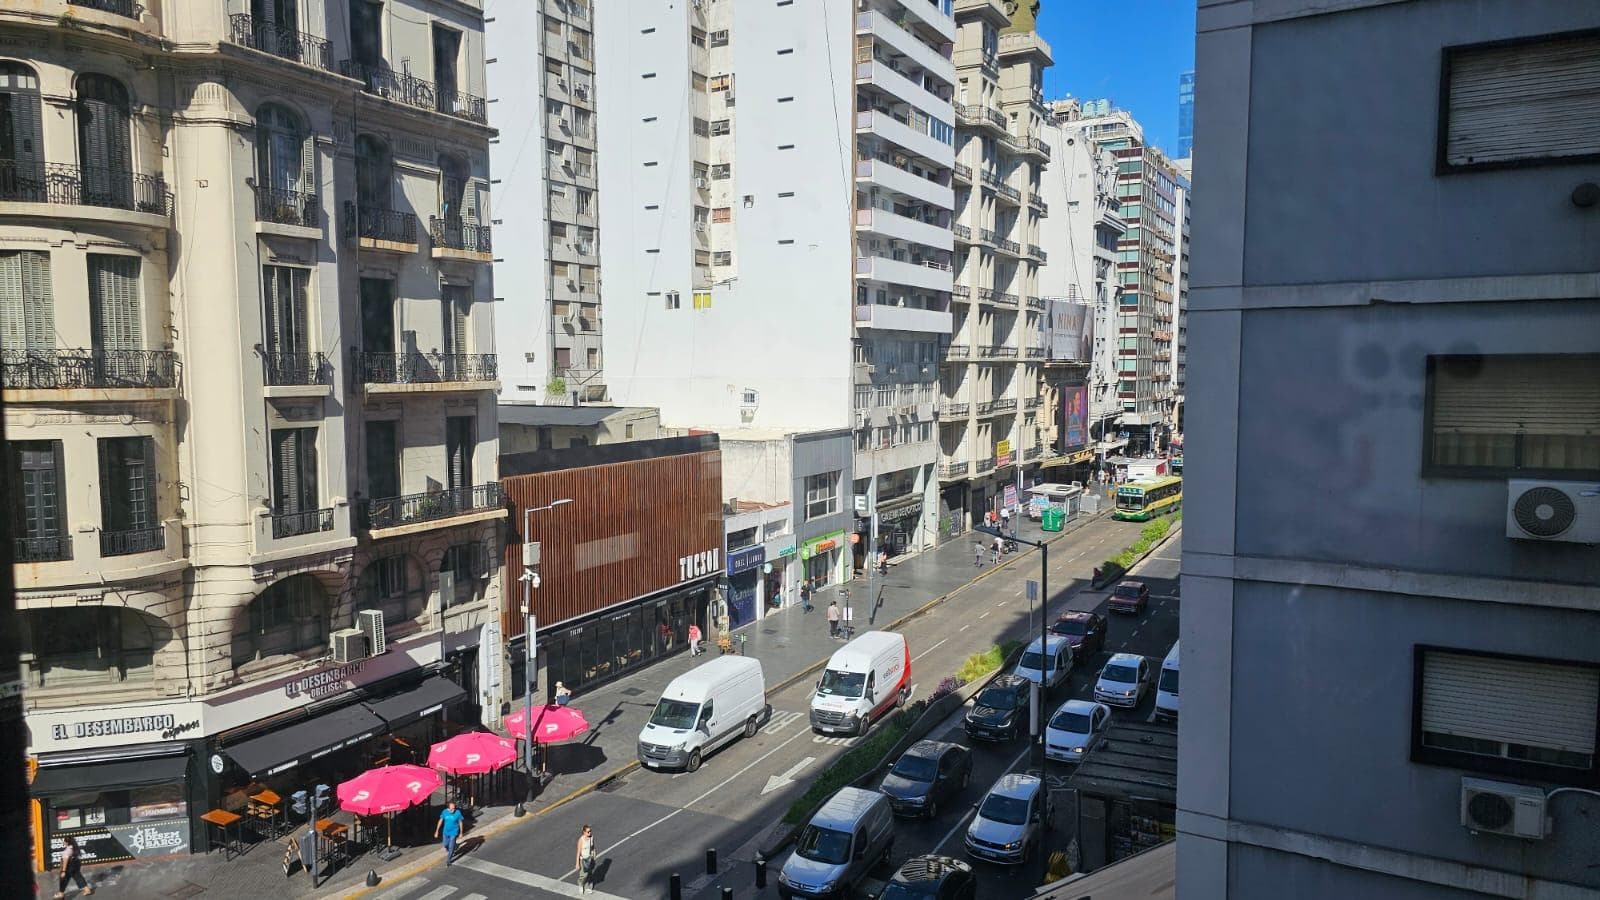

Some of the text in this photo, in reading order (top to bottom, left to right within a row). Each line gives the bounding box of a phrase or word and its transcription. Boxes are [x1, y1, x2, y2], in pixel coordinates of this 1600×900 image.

[680, 547, 719, 581] TUCSON
[286, 661, 365, 696] EL DESEMBARCO
[310, 680, 345, 698] OBELISCO
[52, 714, 174, 740] EL DESEMBARCO
[145, 837, 182, 848] BARCO
